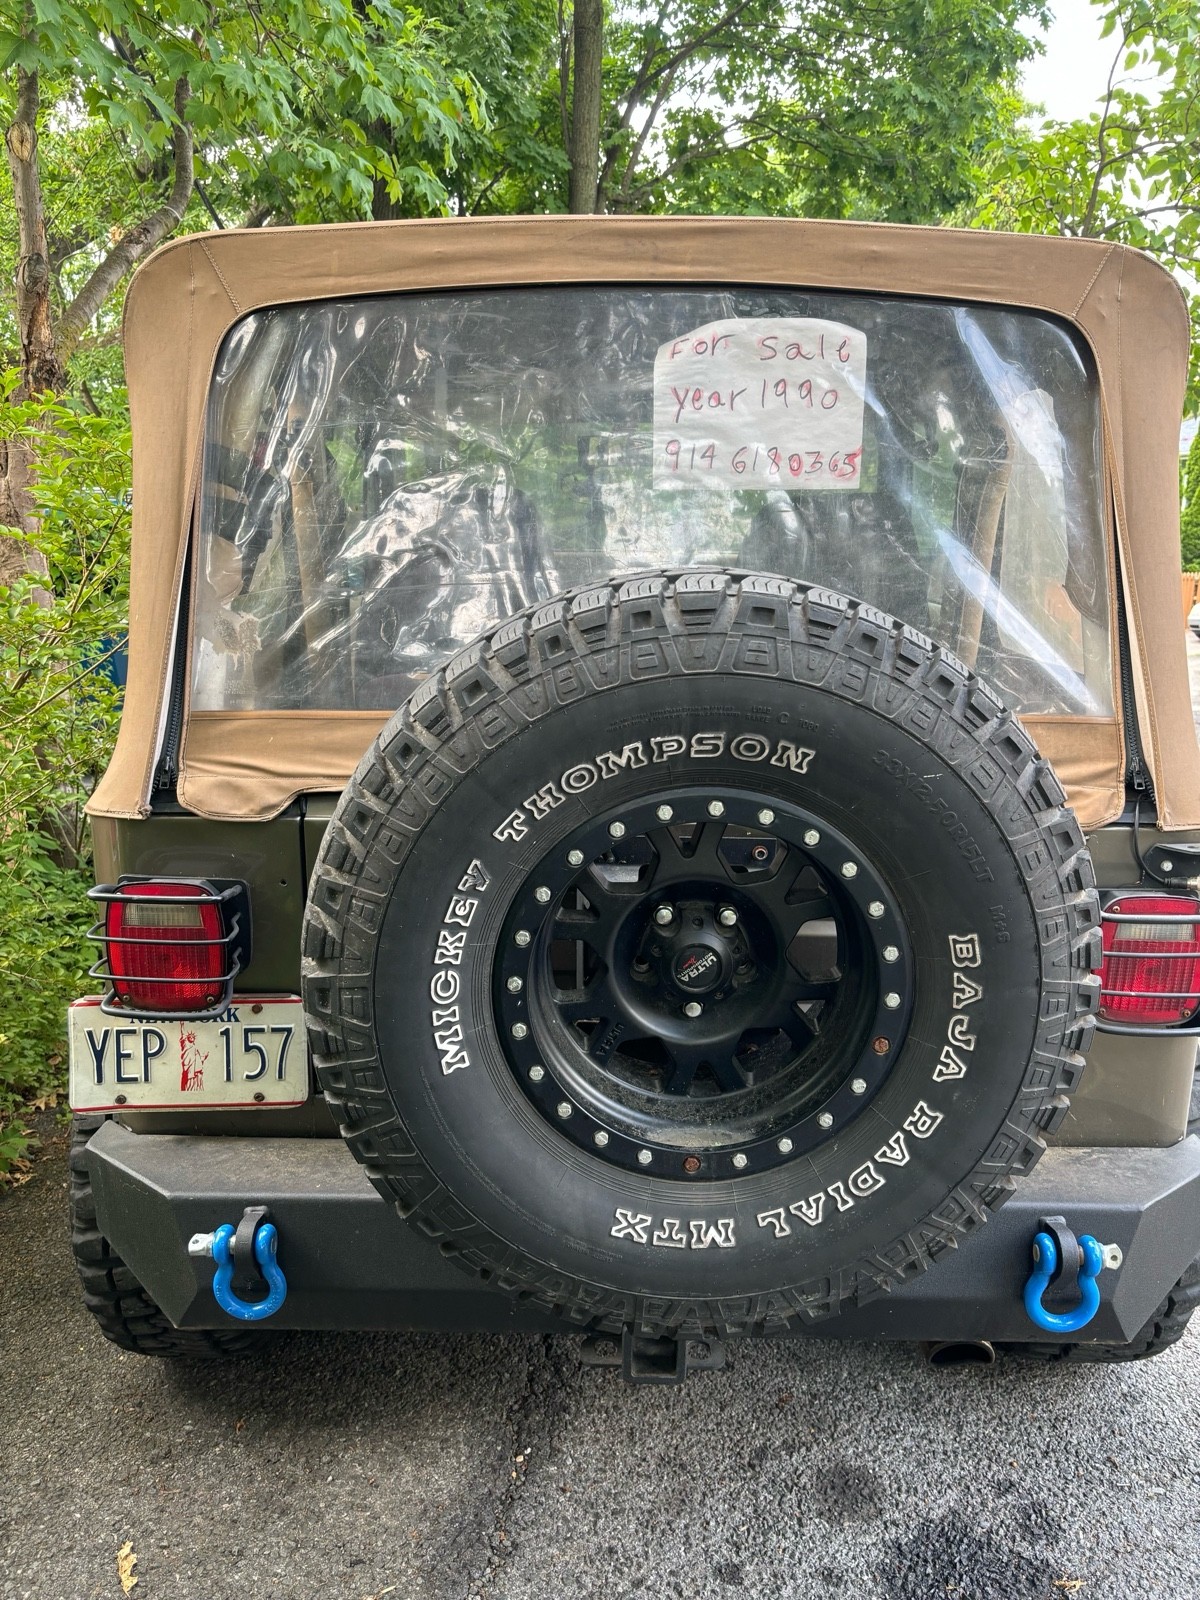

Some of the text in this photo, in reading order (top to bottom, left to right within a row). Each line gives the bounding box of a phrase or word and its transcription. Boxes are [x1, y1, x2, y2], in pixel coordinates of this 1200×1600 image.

[670, 333, 736, 360] For
[761, 377, 839, 410] 1990
[665, 439, 863, 478] 914 6180365
[430, 732, 817, 1076] MICKEY THOMPSON
[680, 955, 718, 982] ULTRA
[84, 1024, 296, 1085] YEP 157
[609, 932, 983, 1250] BAJA RADIAL MTX
